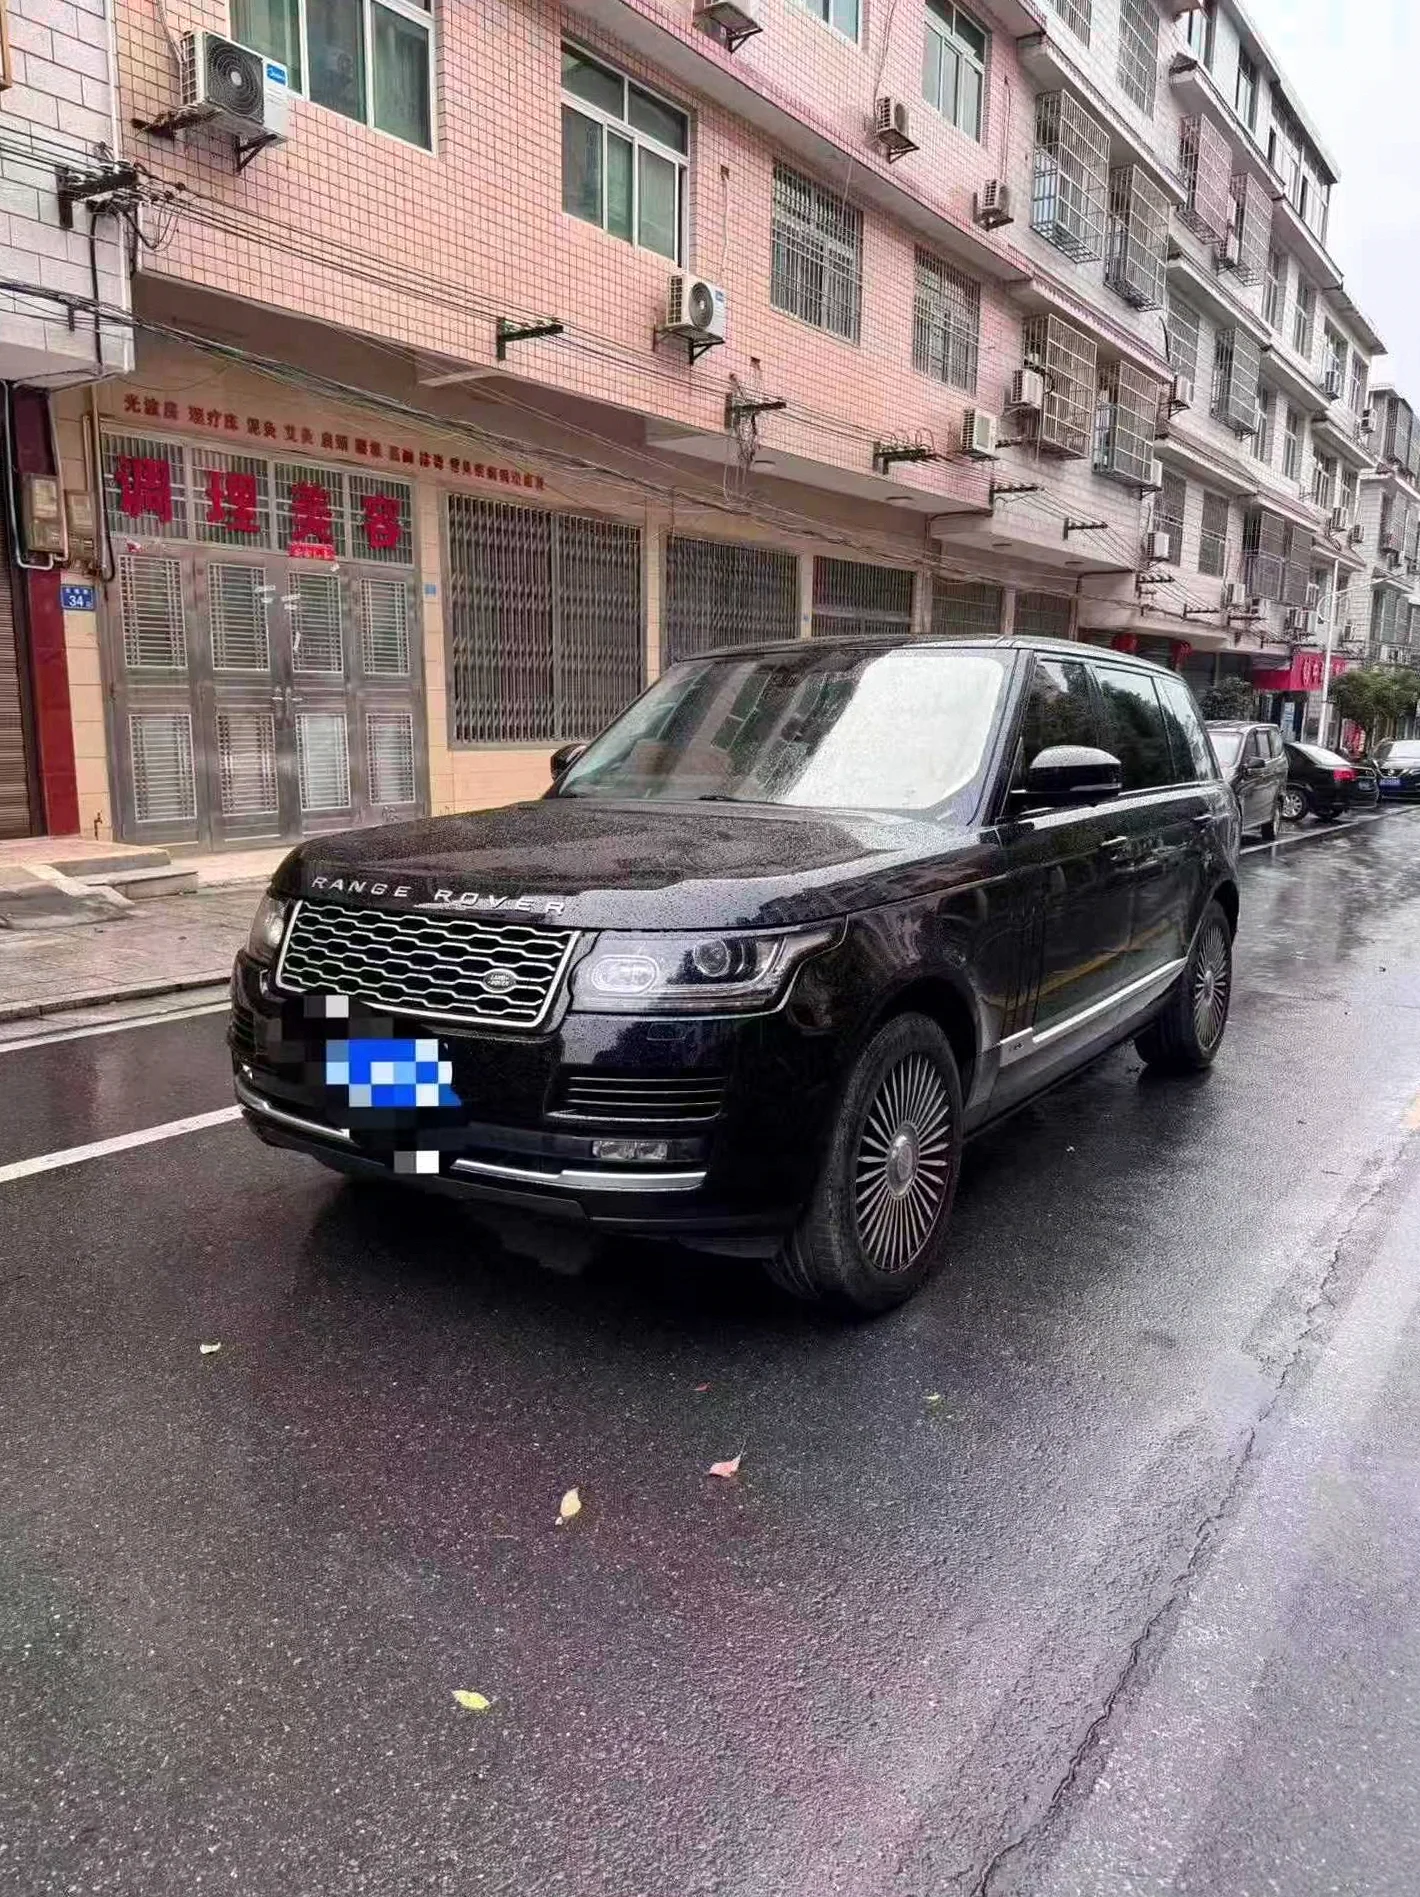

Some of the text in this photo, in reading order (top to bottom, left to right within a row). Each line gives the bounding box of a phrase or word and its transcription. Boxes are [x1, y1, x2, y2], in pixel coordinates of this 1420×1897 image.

[114, 455, 402, 550] 调理美容
[311, 876, 566, 915] RANGE ROVER
